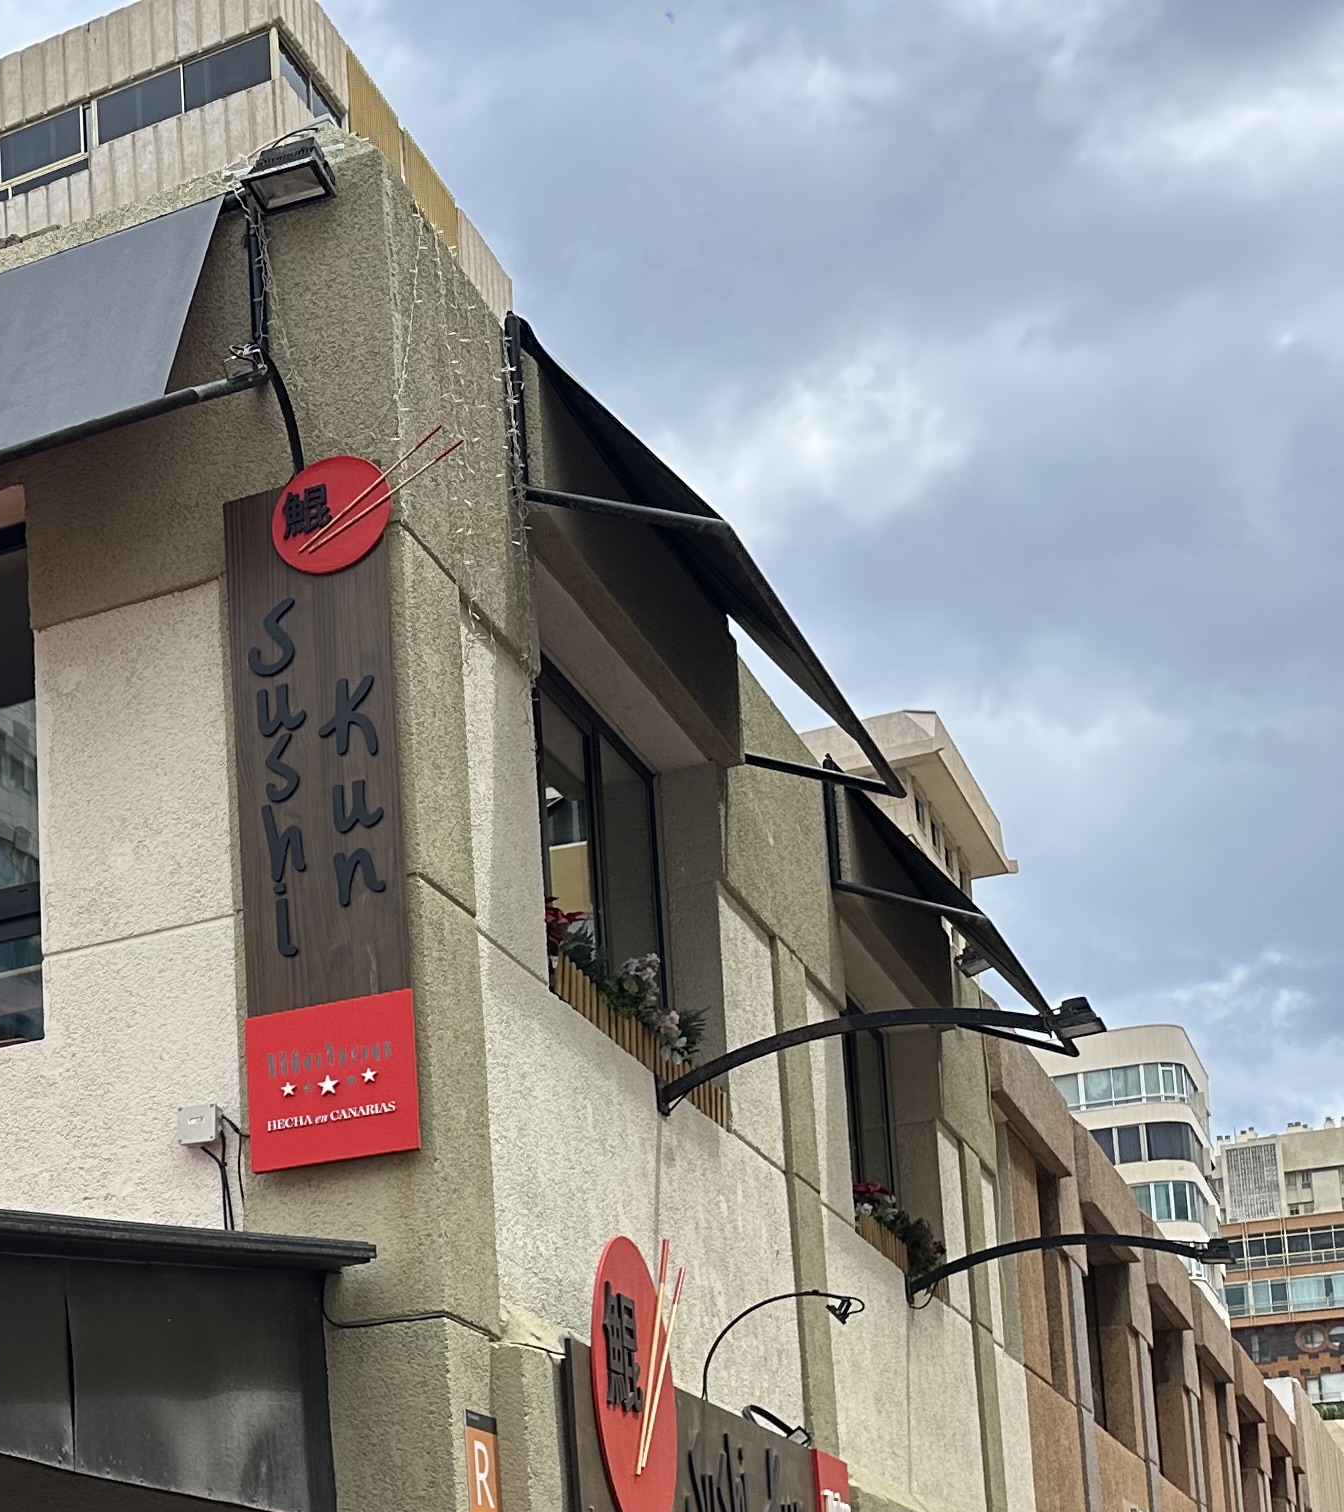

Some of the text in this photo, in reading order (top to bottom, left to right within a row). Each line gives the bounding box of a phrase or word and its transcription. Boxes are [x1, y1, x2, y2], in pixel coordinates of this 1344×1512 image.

[248, 597, 307, 958] Sushi
[318, 675, 386, 907] Kun
[267, 1101, 396, 1133] HECHA en CANARIAS
[473, 1440, 495, 1509] R
